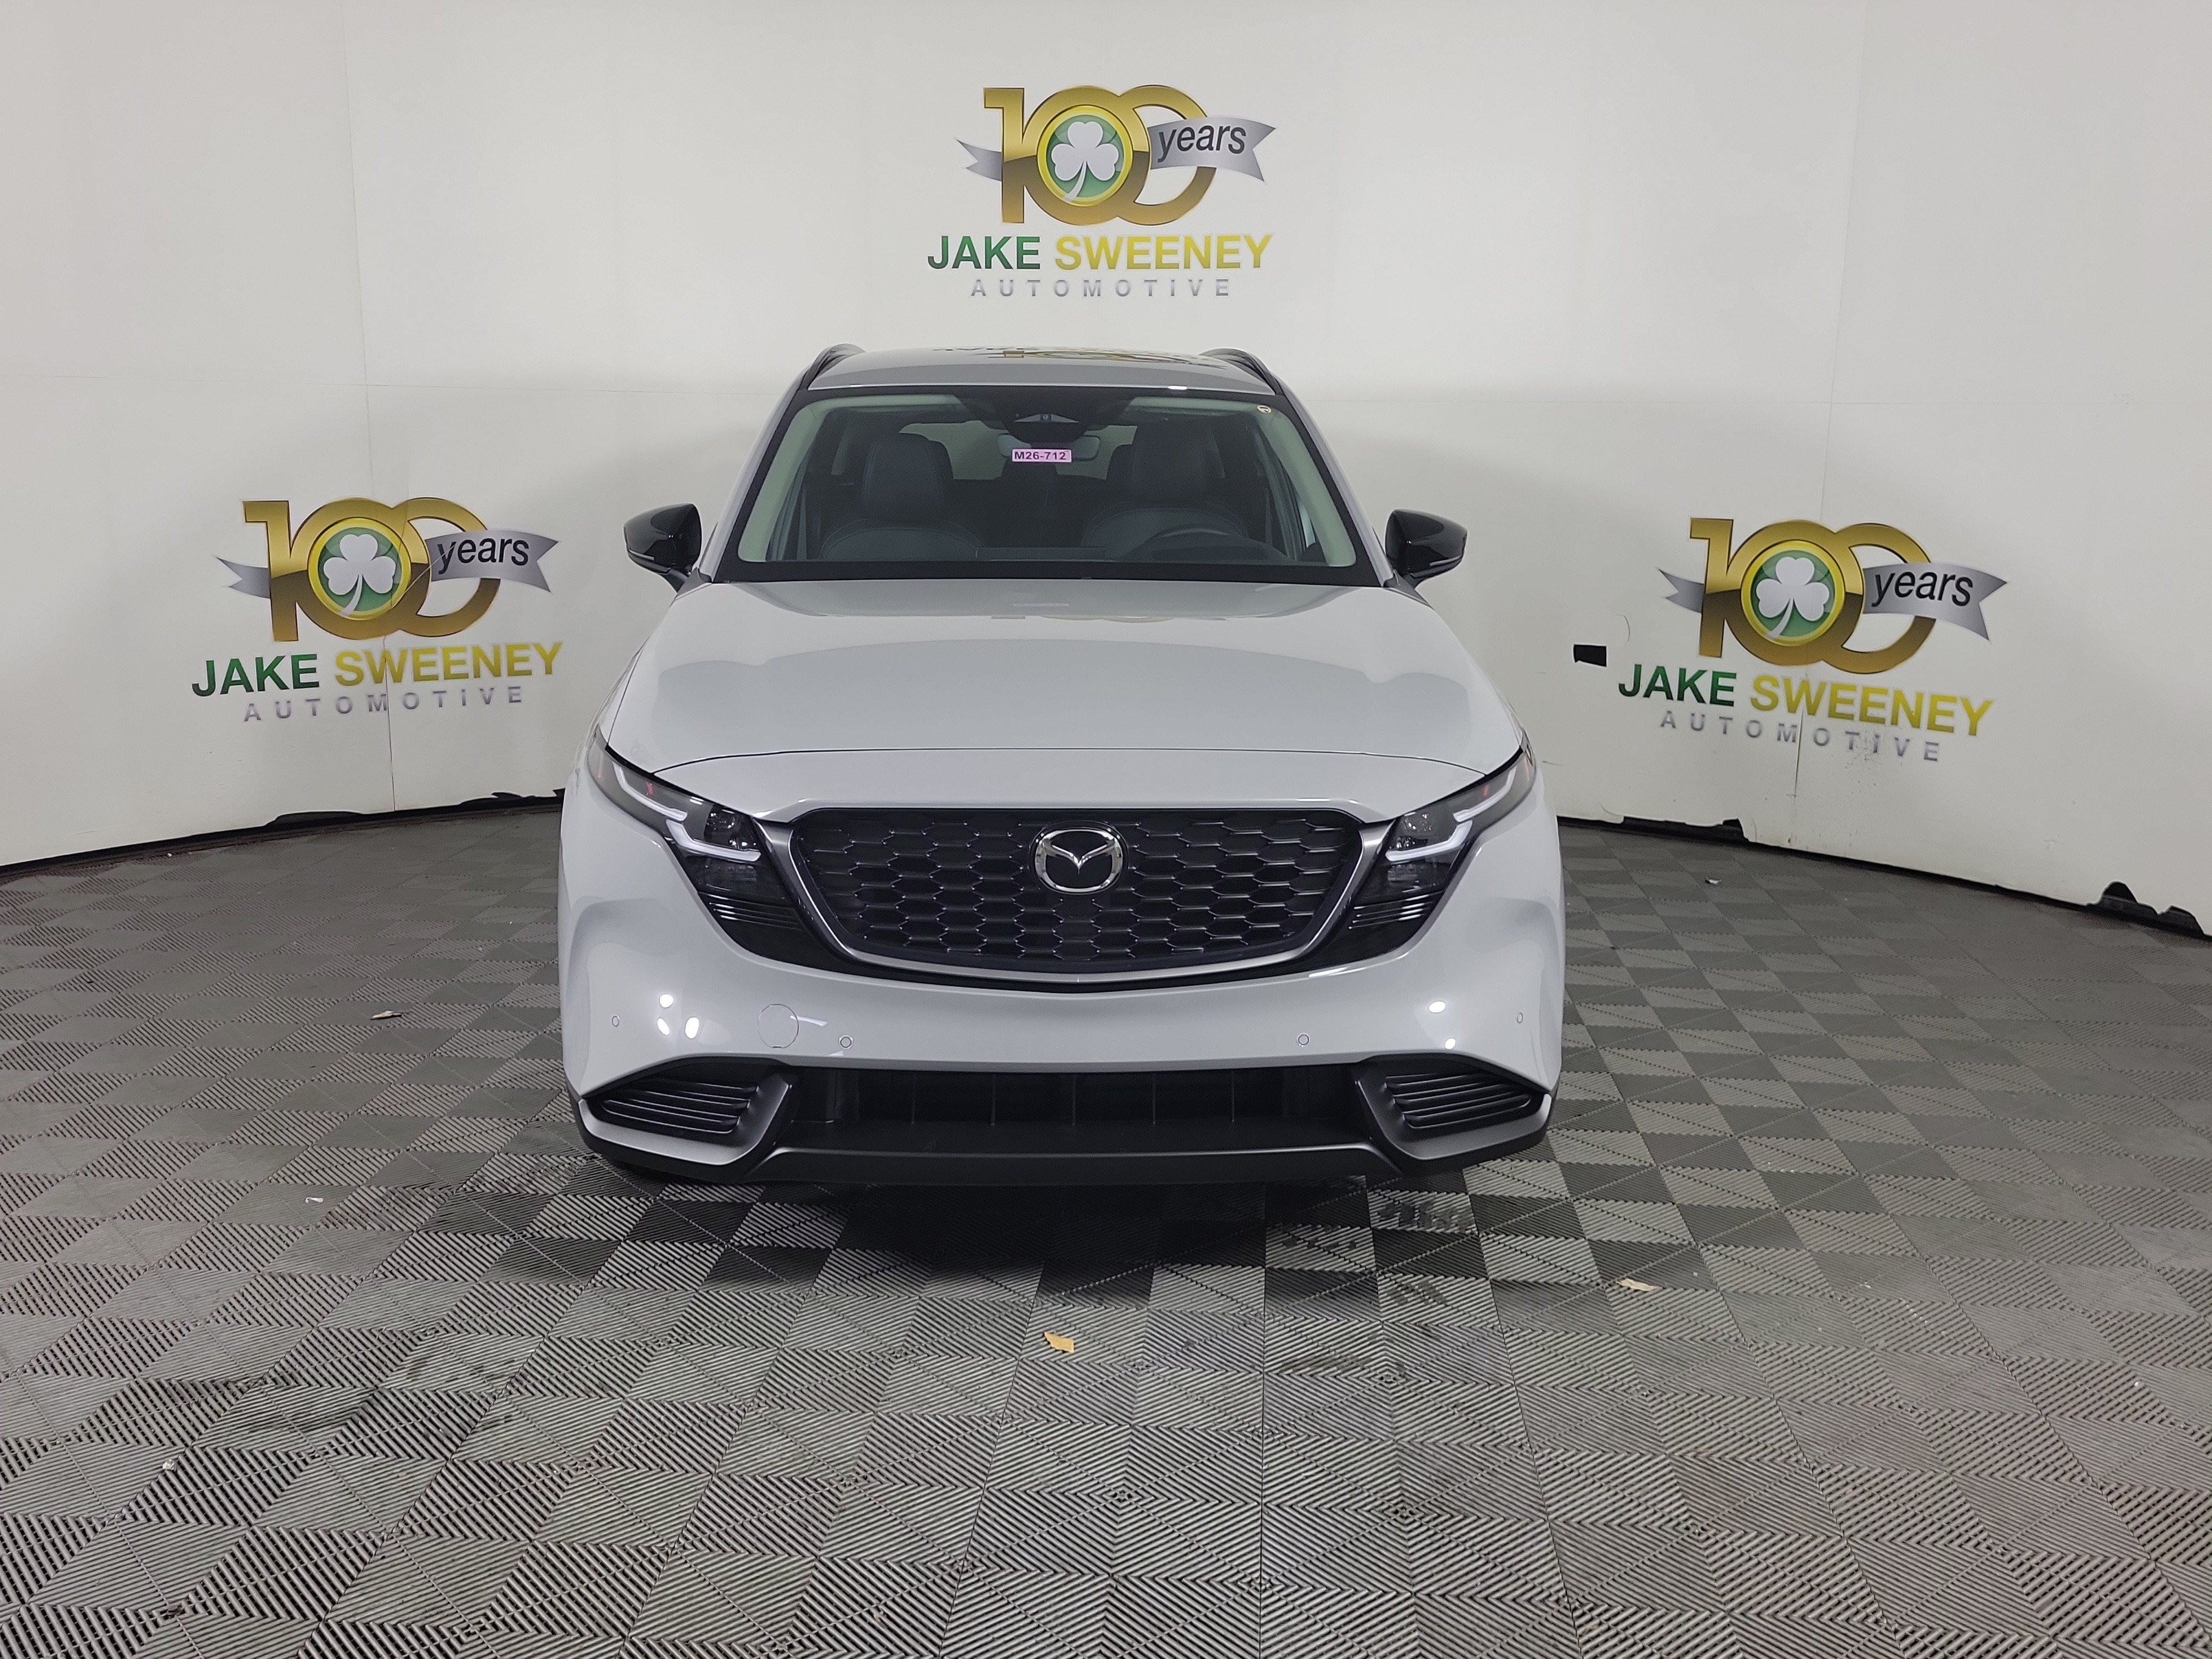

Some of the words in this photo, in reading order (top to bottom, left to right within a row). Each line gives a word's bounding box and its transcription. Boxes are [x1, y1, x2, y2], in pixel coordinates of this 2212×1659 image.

[983, 84, 1216, 226] 100
[1158, 125, 1246, 163] years
[928, 236, 1041, 270] JAKE
[1054, 234, 1273, 270] SWEENEY
[970, 279, 1229, 297] AUTOMOTIVE
[1014, 452, 1066, 460] M26-712
[243, 497, 500, 642] 100
[437, 537, 529, 574] years
[1690, 517, 1937, 674] 100
[1871, 568, 1974, 607] years
[192, 653, 319, 697] JAKE
[335, 642, 562, 686] SWEENEY
[244, 686, 522, 723] AUTOMOTIVE
[1618, 664, 1737, 707] JAKE
[1750, 675, 1994, 736] SWEENEY
[1660, 709, 1939, 762] AUTOMOTIVE
